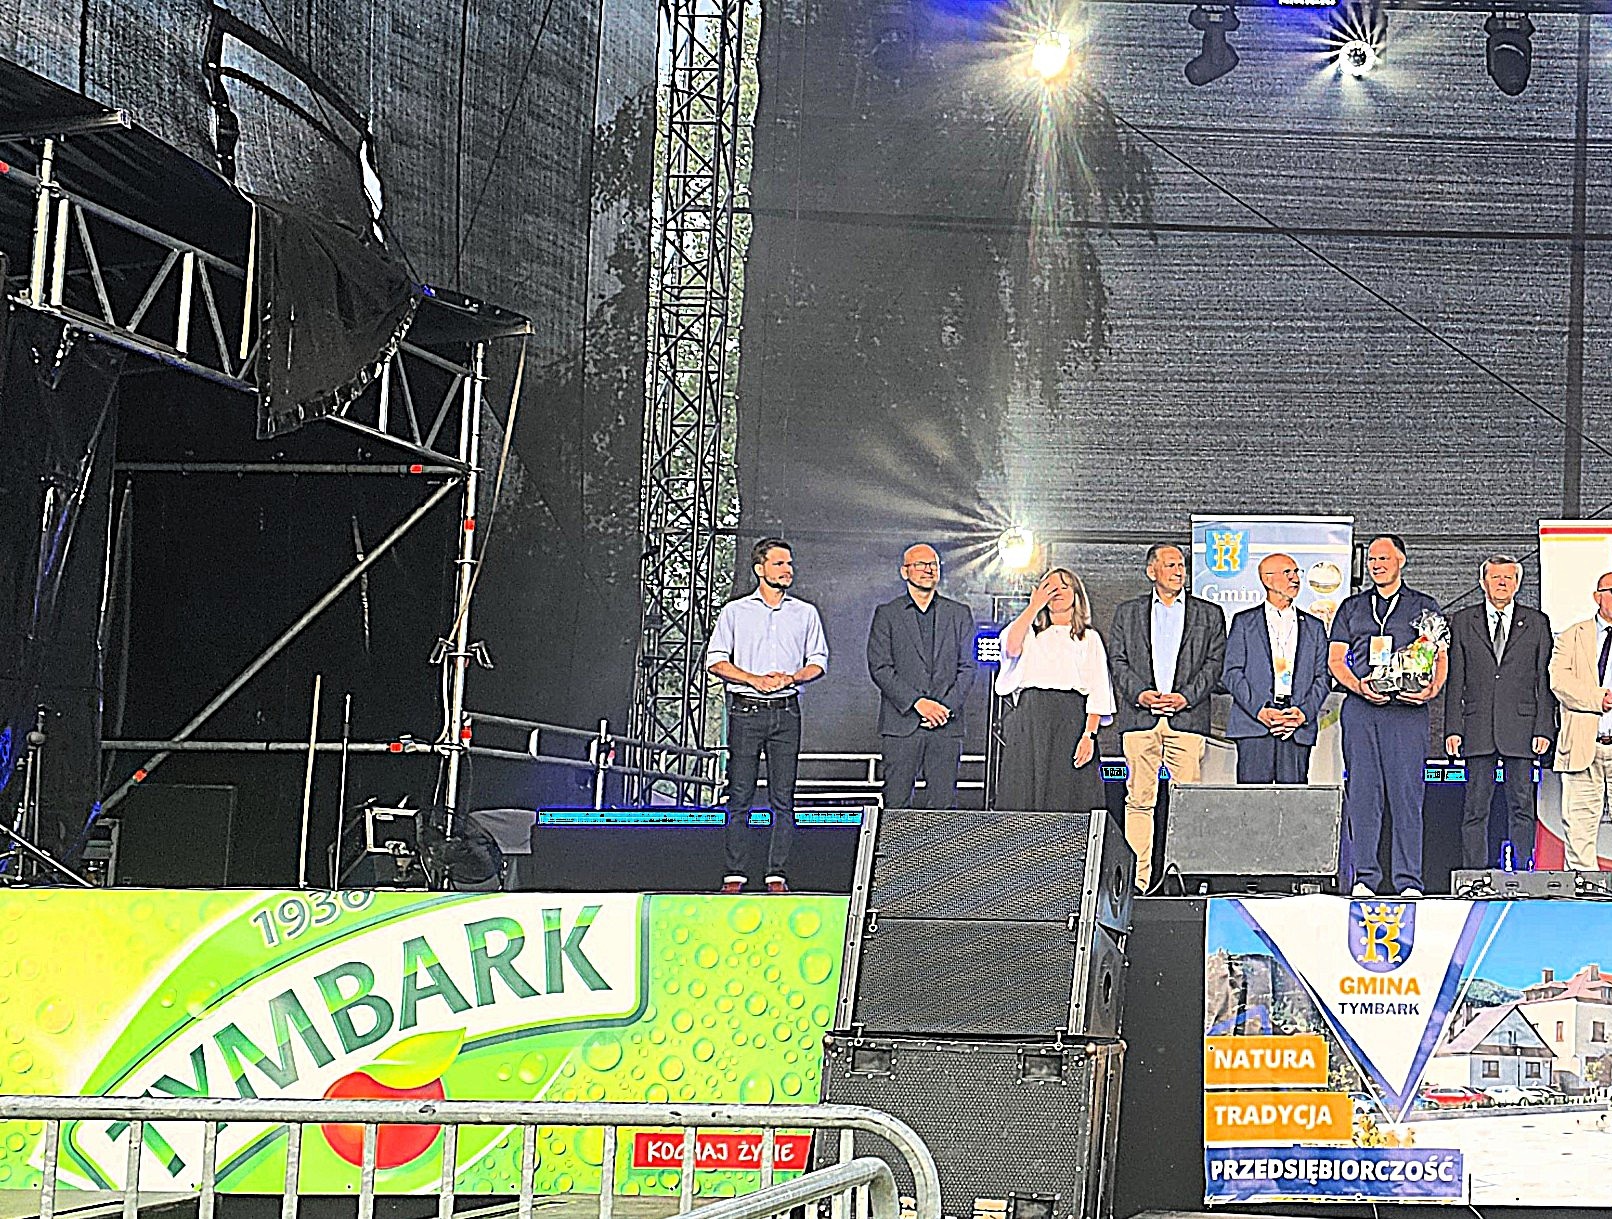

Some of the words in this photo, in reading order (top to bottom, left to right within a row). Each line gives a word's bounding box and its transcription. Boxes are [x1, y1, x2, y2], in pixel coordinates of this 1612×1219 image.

[1202, 584, 1262, 602] Gmin
[1339, 975, 1421, 996] GMINA
[1338, 1001, 1420, 1016] TYMBARK
[1213, 1048, 1315, 1069] NATURA
[1214, 1104, 1333, 1129] TRADYCJA
[737, 1140, 795, 1163] ŻYIE
[1210, 1154, 1454, 1186] PRZEDSIĘBIORCZOŚĆ
